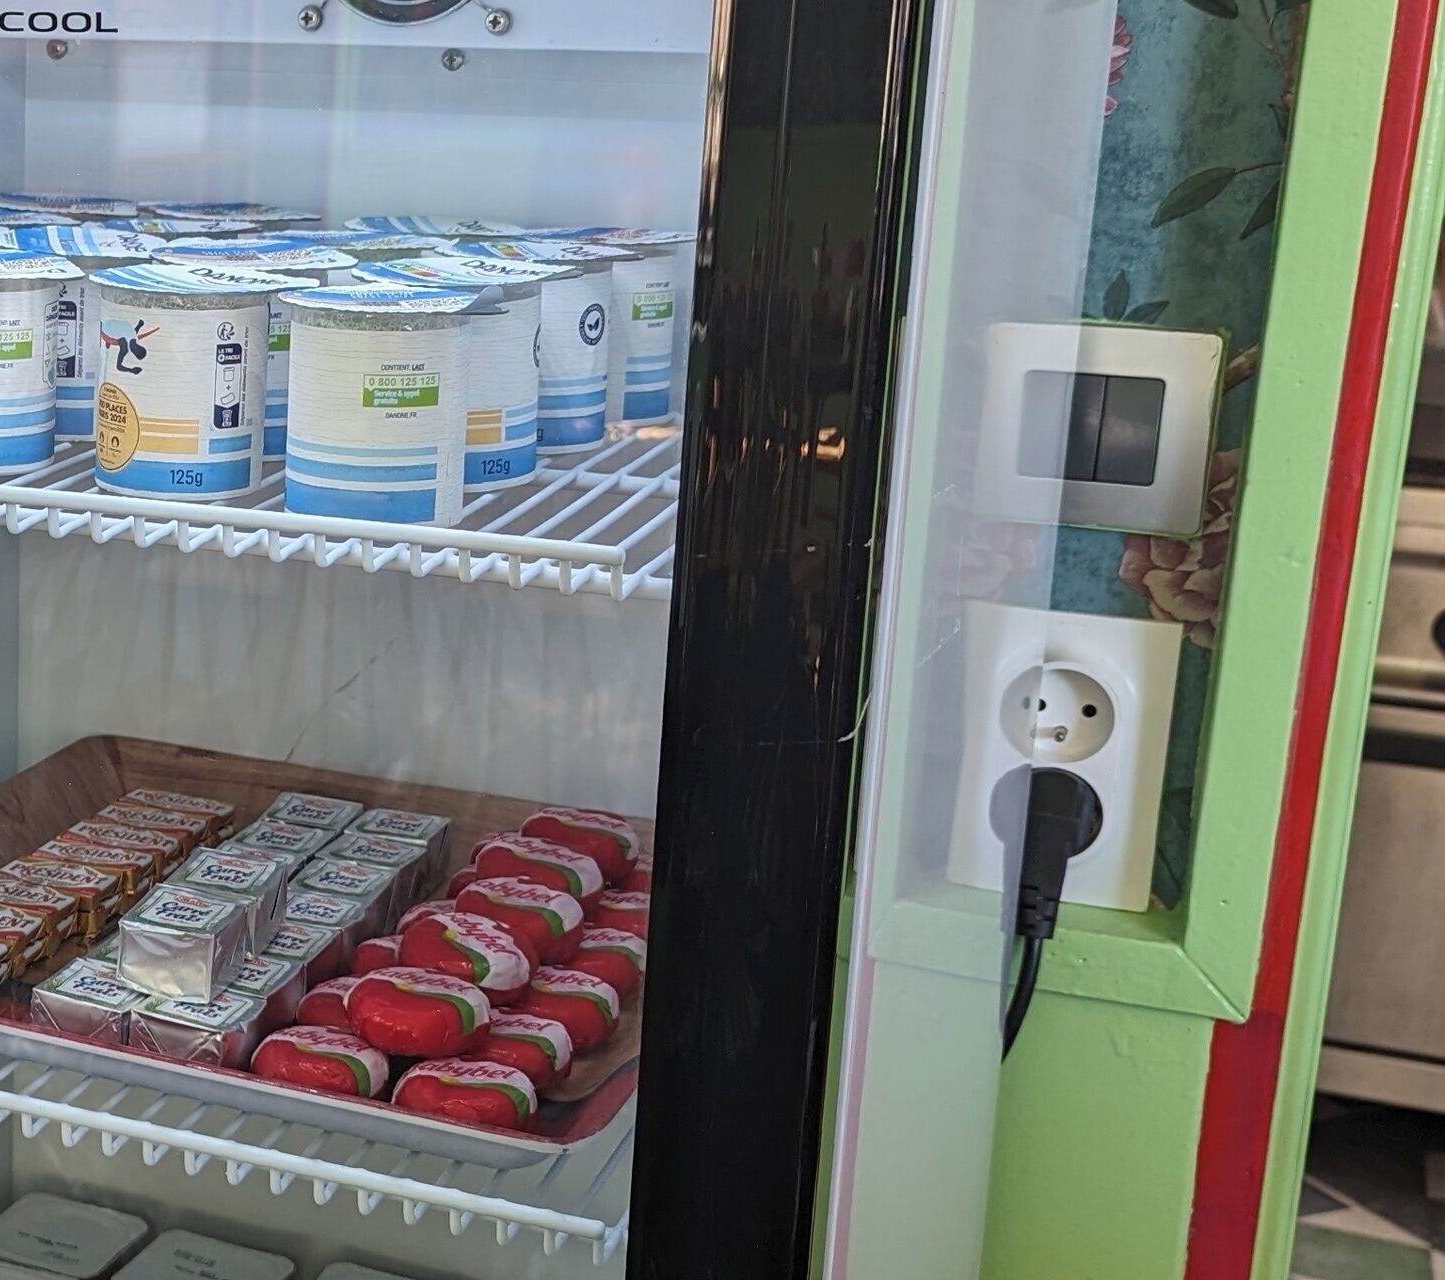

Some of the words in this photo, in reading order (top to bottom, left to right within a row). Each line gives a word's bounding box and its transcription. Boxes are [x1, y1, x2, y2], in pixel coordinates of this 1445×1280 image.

[0, 333, 14, 341] 125
[16, 332, 30, 340] 125
[369, 377, 375, 386] 0
[378, 377, 396, 386] 800
[400, 376, 417, 386] 125
[421, 375, 436, 385] 125
[105, 403, 127, 415] PLACES
[110, 413, 126, 424] 2024
[481, 458, 510, 477] 125g
[169, 470, 203, 487] 125g
[476, 880, 563, 903] abybel
[417, 1062, 519, 1079] abybel
